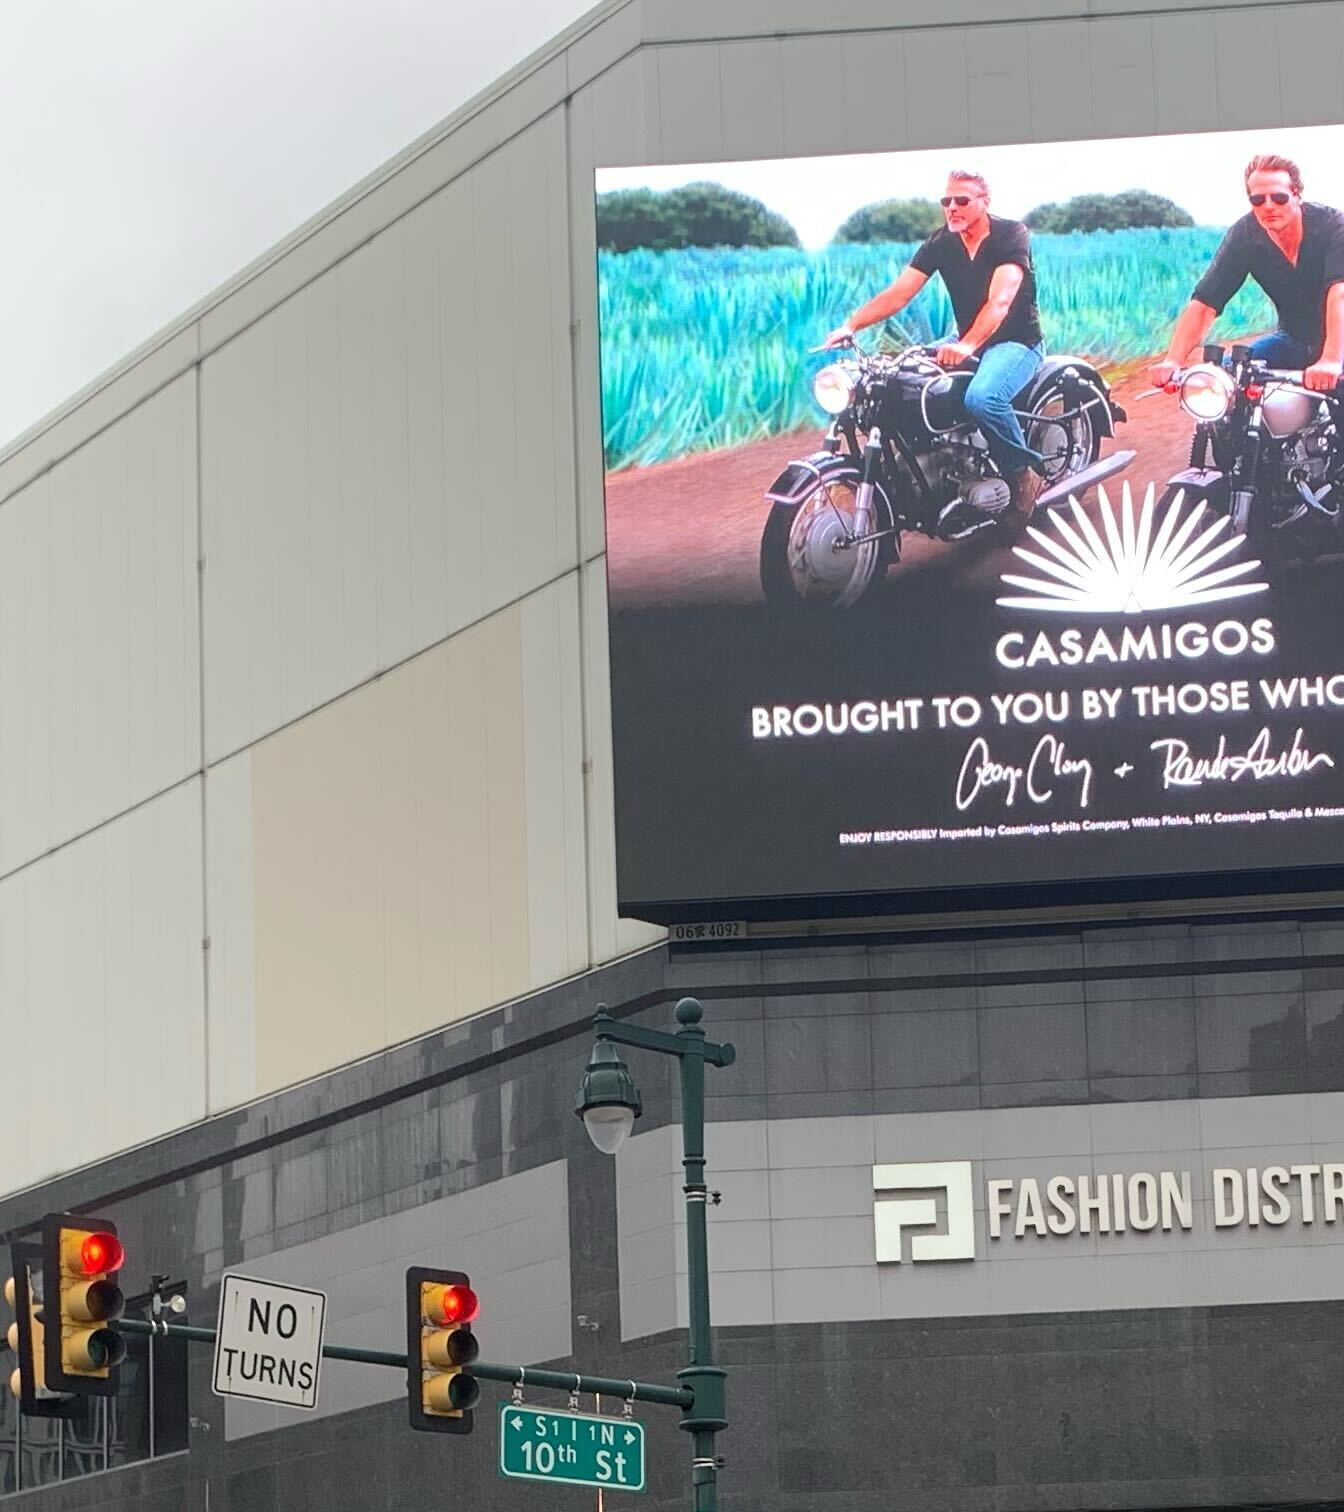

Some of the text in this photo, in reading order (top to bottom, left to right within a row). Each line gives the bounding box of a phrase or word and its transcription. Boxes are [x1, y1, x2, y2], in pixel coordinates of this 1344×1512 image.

[996, 618, 1276, 668] CASAMIGOS
[751, 699, 923, 738] BROUGHT
[932, 696, 981, 728] TO
[991, 691, 1068, 725] YOU
[1082, 687, 1122, 720] BY
[1131, 681, 1249, 716] THOSE
[840, 832, 872, 845] ENJOY
[874, 829, 937, 843] RESPONSIBLY
[940, 826, 982, 840] Imported
[985, 826, 996, 839] by
[998, 823, 1050, 836] Casamigos
[1052, 821, 1081, 834] Spirits
[1083, 818, 1131, 832] Company,
[1132, 816, 1160, 828] White
[1162, 815, 1194, 827] Plains,
[1195, 813, 1213, 825] NY,
[1214, 810, 1267, 824] Casamigos
[1269, 807, 1303, 821] Tequila
[1305, 807, 1313, 818] &
[988, 1170, 1192, 1239] FASHION
[248, 1298, 297, 1339] NO
[223, 1348, 313, 1390] TURNS
[521, 1440, 627, 1482] 10th St
